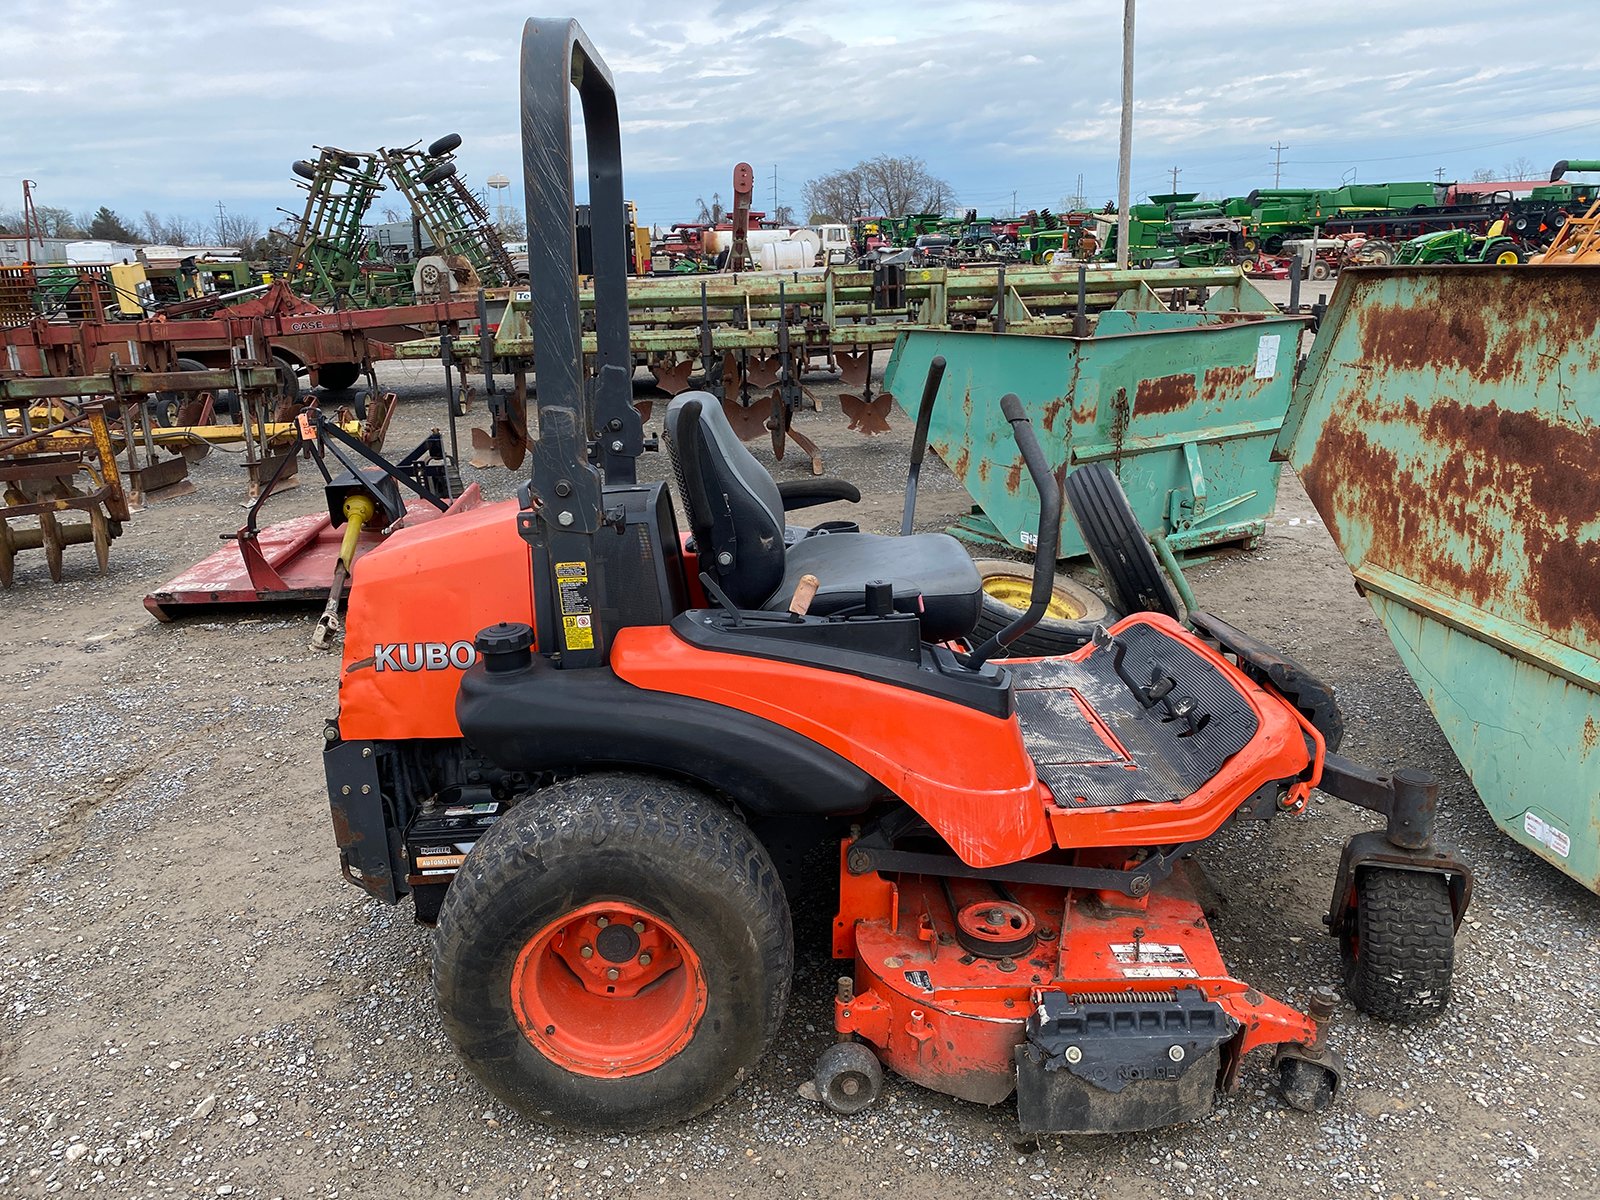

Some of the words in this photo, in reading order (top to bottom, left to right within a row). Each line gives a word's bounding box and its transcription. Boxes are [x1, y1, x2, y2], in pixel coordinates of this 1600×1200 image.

[292, 321, 323, 332] CASE
[374, 640, 476, 672] KUBO
[422, 858, 460, 866] AUTOMOTIVE
